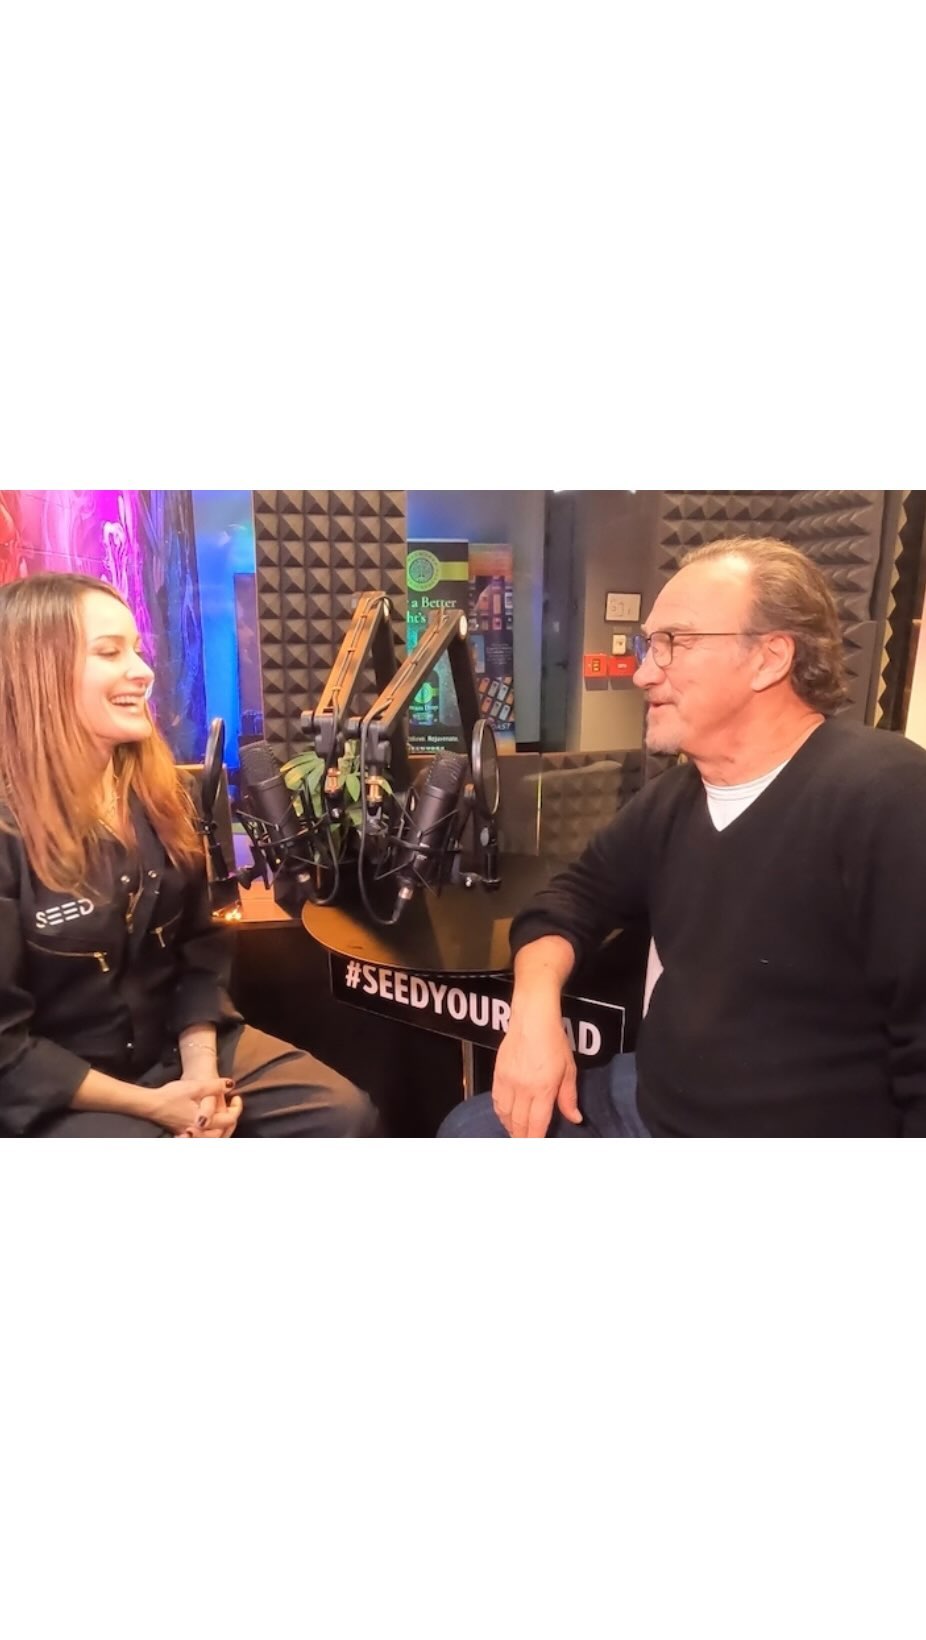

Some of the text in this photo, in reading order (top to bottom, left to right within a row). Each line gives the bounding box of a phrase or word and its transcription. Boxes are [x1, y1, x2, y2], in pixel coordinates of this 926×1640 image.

[411, 596, 457, 608] a Better
[35, 898, 94, 928] SEED
[345, 960, 602, 1056] #SEEDYOURAD
